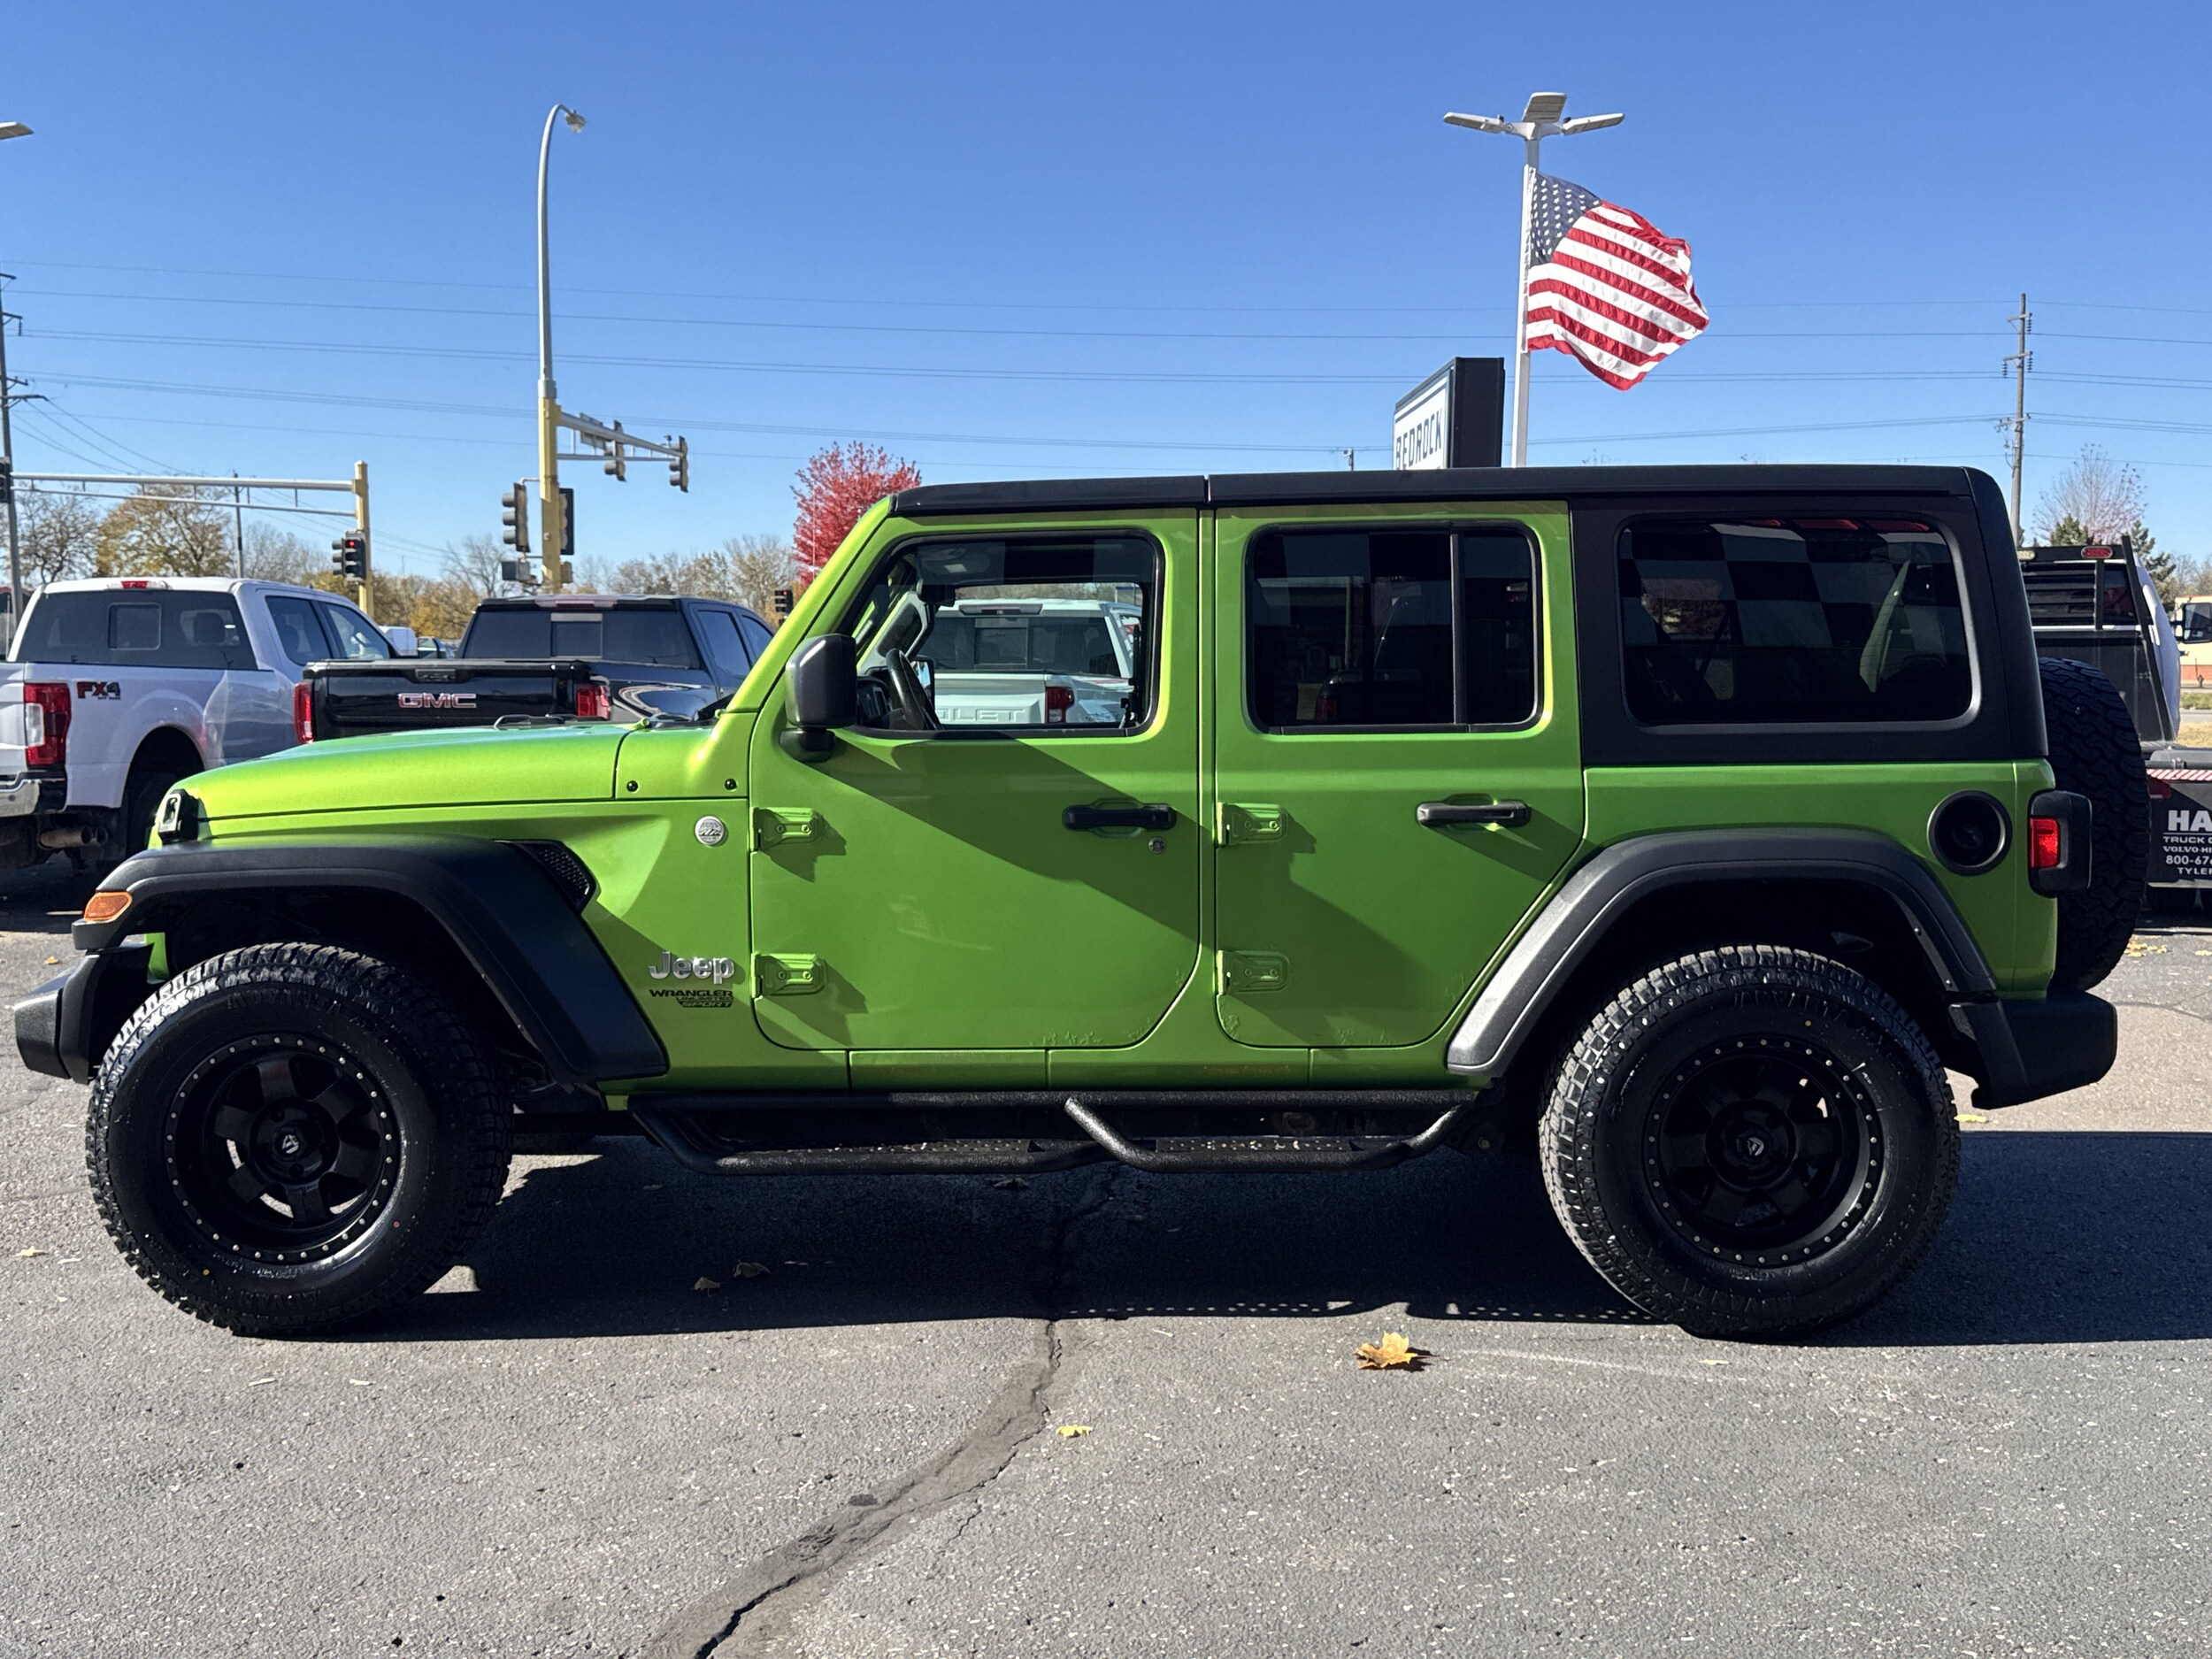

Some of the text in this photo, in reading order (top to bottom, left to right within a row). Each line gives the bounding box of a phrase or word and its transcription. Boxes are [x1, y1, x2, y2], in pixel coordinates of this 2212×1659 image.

[1395, 407, 1442, 471] BEDROCK
[76, 681, 120, 699] FX4
[397, 692, 477, 709] GMC
[649, 951, 734, 985] Jeep
